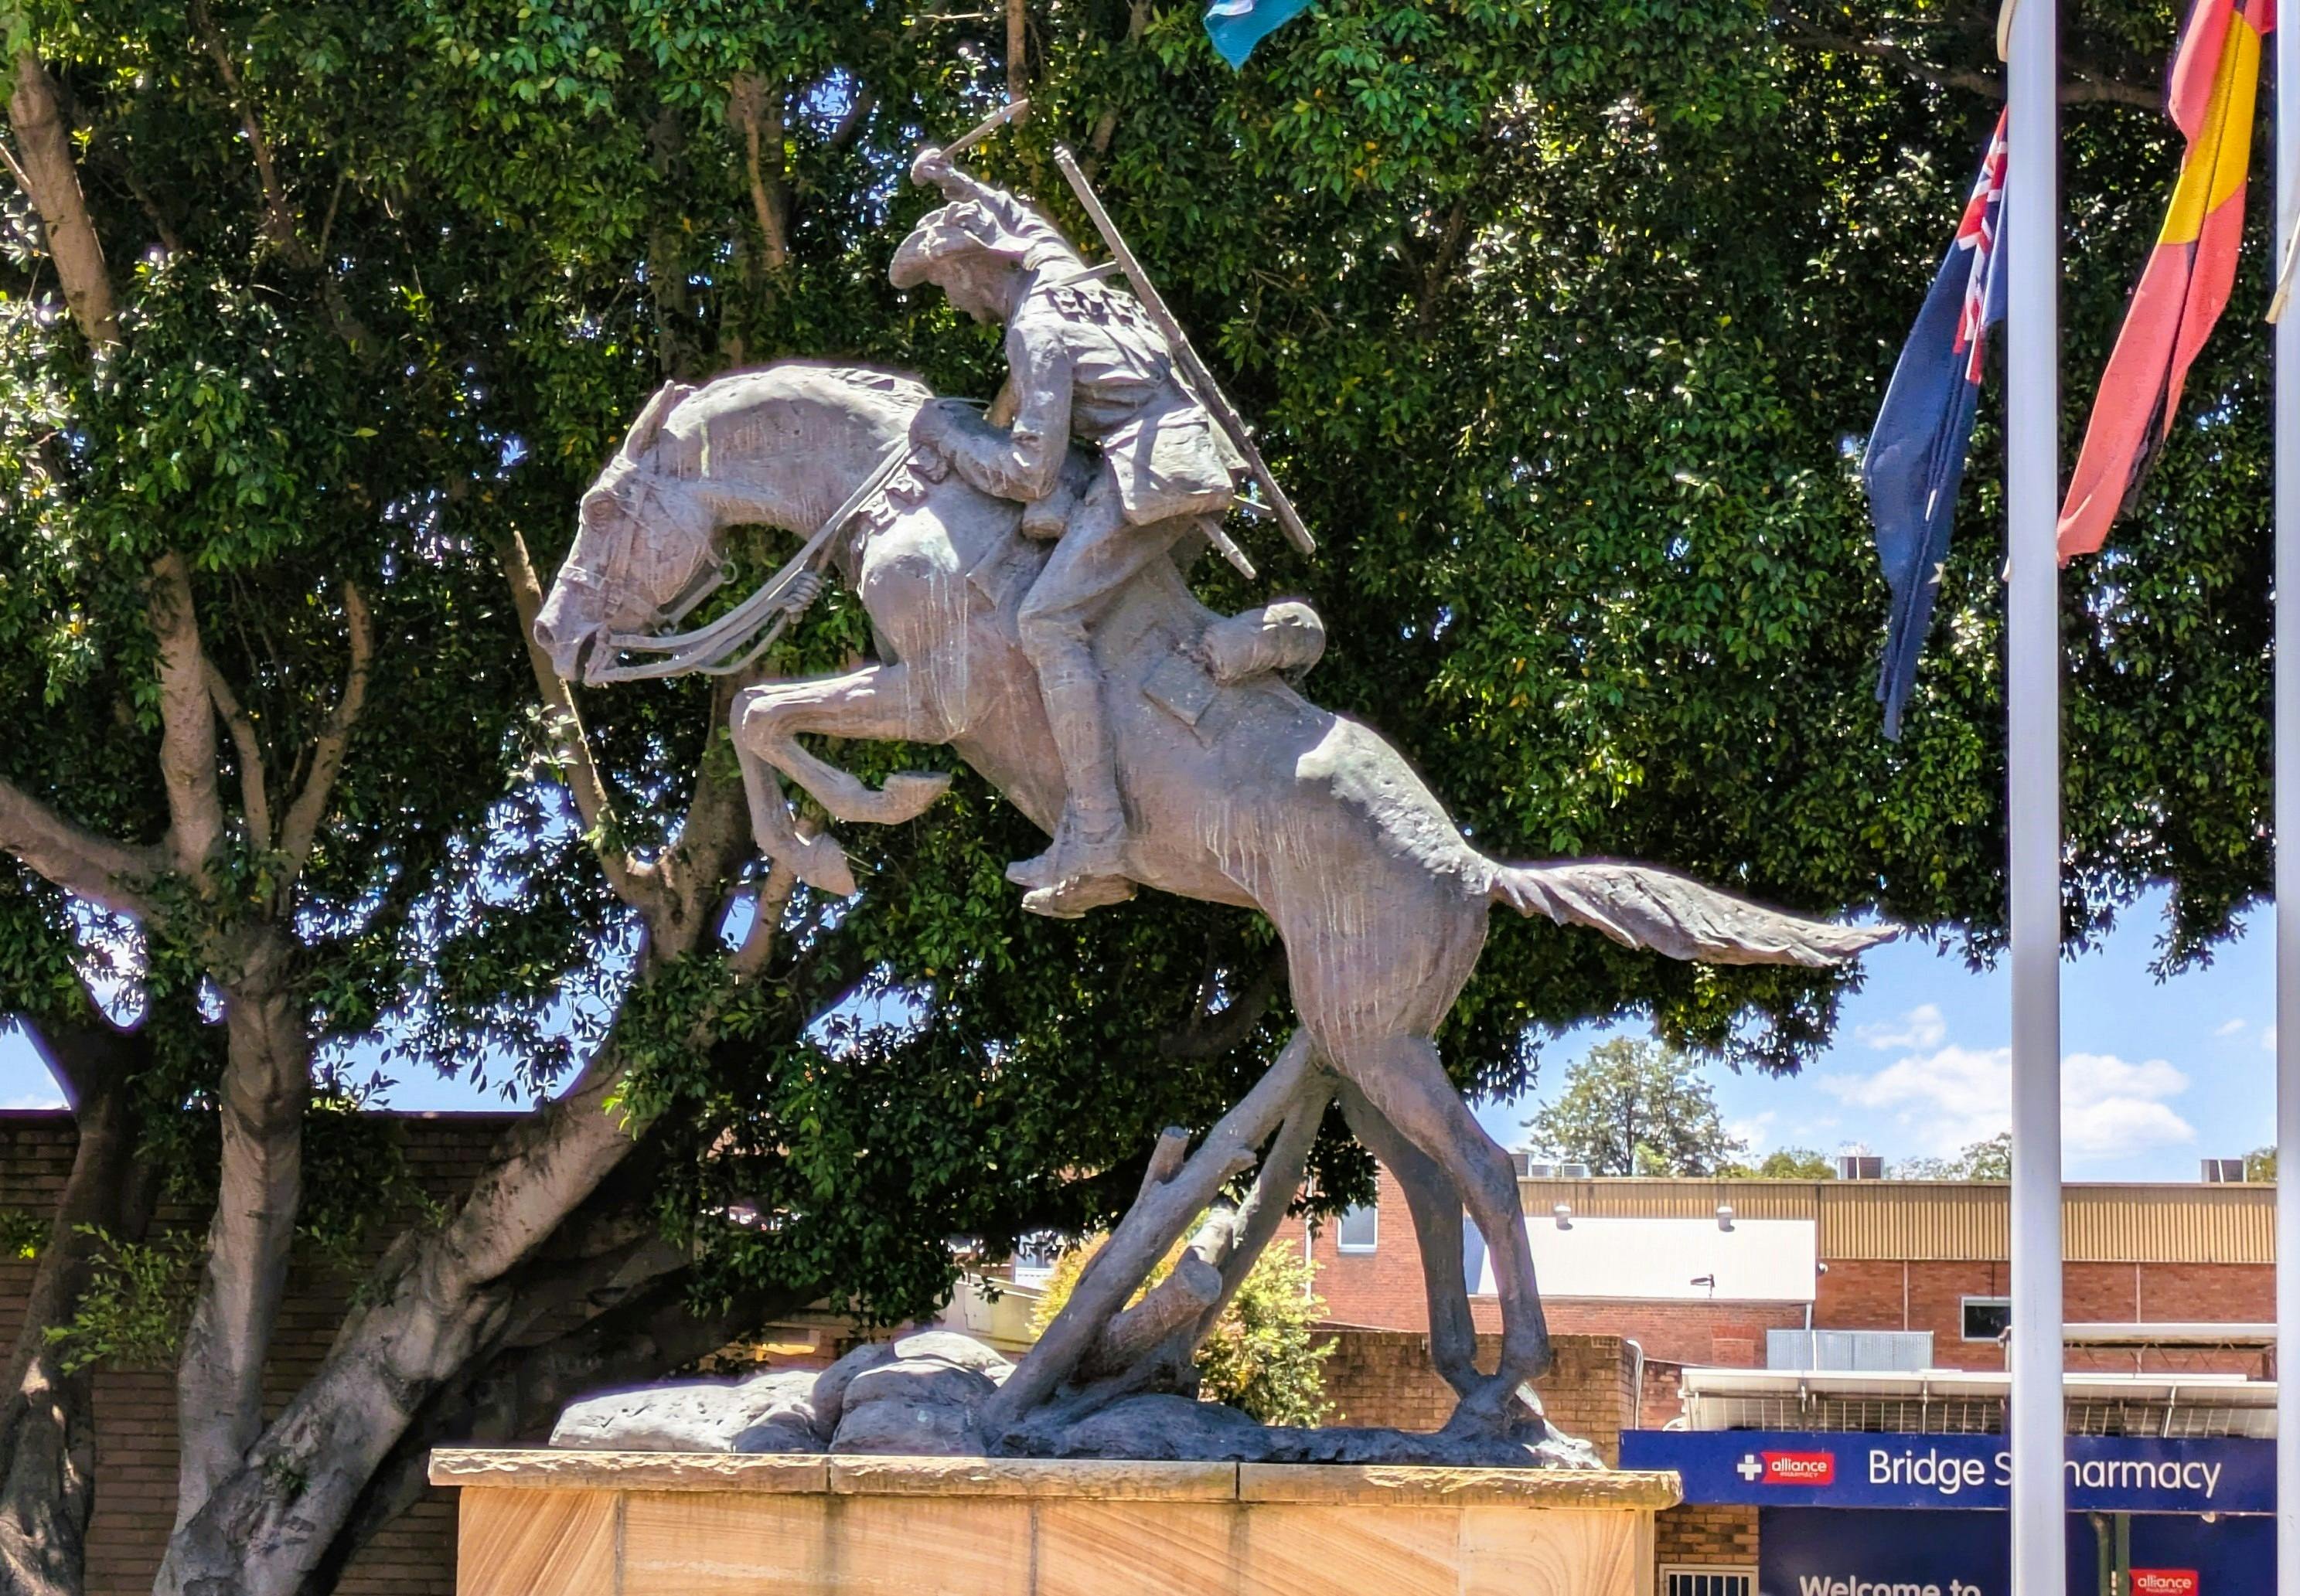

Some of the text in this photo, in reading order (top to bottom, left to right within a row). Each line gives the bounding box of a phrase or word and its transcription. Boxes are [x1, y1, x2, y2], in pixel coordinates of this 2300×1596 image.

[1771, 1457, 1827, 1472] alliance
[1869, 1448, 2221, 1498] Bridge S armacy
[1799, 1575, 1981, 1596] Welcome to
[2137, 1574, 2192, 1588] alliance
